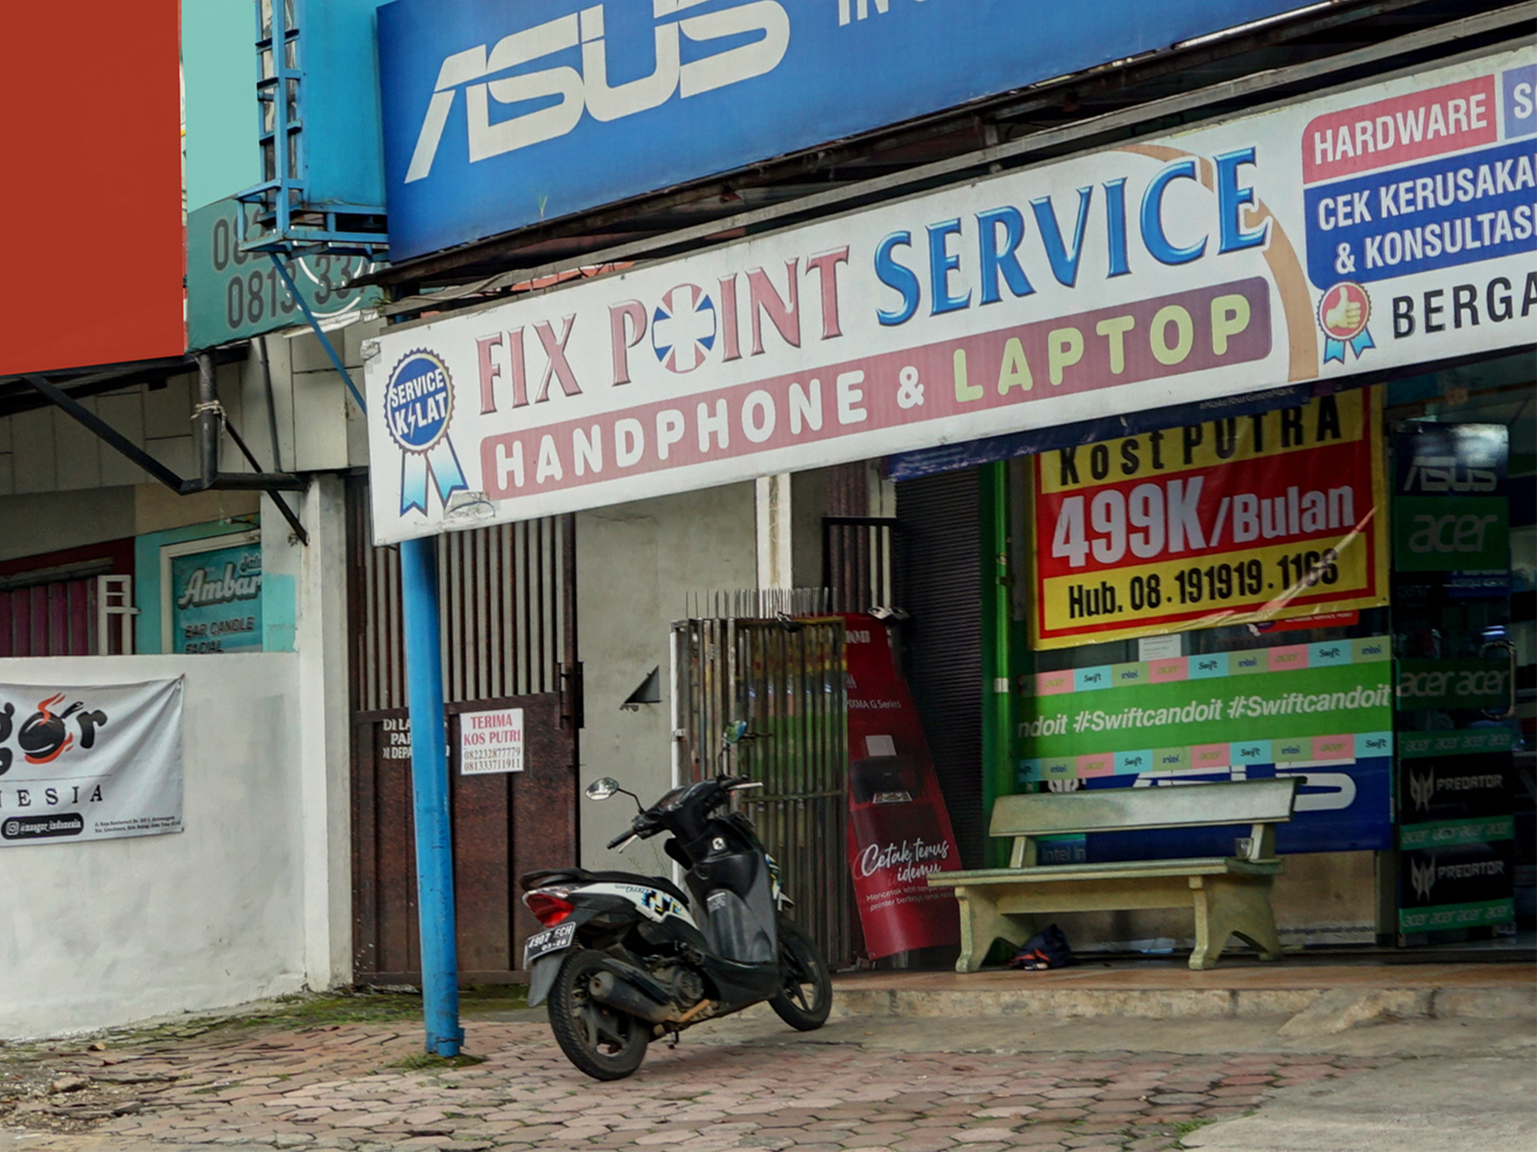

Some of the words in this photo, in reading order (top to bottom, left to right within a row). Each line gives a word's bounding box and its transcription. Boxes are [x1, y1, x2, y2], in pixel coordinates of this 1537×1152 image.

[1314, 93, 1488, 165] HARDWARE
[1318, 189, 1373, 231] CEK
[1335, 241, 1356, 275] &
[475, 312, 583, 415] FIX
[874, 145, 1273, 327] SERVICE
[390, 368, 445, 408] SERVICE
[495, 369, 868, 492] HANDPHONE
[897, 364, 925, 410] &
[952, 293, 1252, 404] LAPTOP
[1182, 395, 1342, 466] PUTRA
[1403, 455, 1497, 492] ASUS
[1408, 513, 1499, 554] acer
[1068, 580, 1123, 619] Hub.
[184, 623, 207, 639] EAR
[210, 616, 255, 635] CANDLE
[1397, 671, 1456, 698] acer
[1456, 670, 1511, 696] acer
[470, 713, 513, 729] TERIMA
[1072, 698, 1224, 734] #Swiftcandoit
[1227, 682, 1392, 719] #Swiftcandoit
[463, 732, 486, 746] KOS
[489, 729, 521, 744] PUTRI
[1436, 774, 1504, 791] PREDATOR
[861, 840, 913, 877] Cetak
[913, 837, 950, 862] terus
[1437, 860, 1505, 880] PREDATOR
